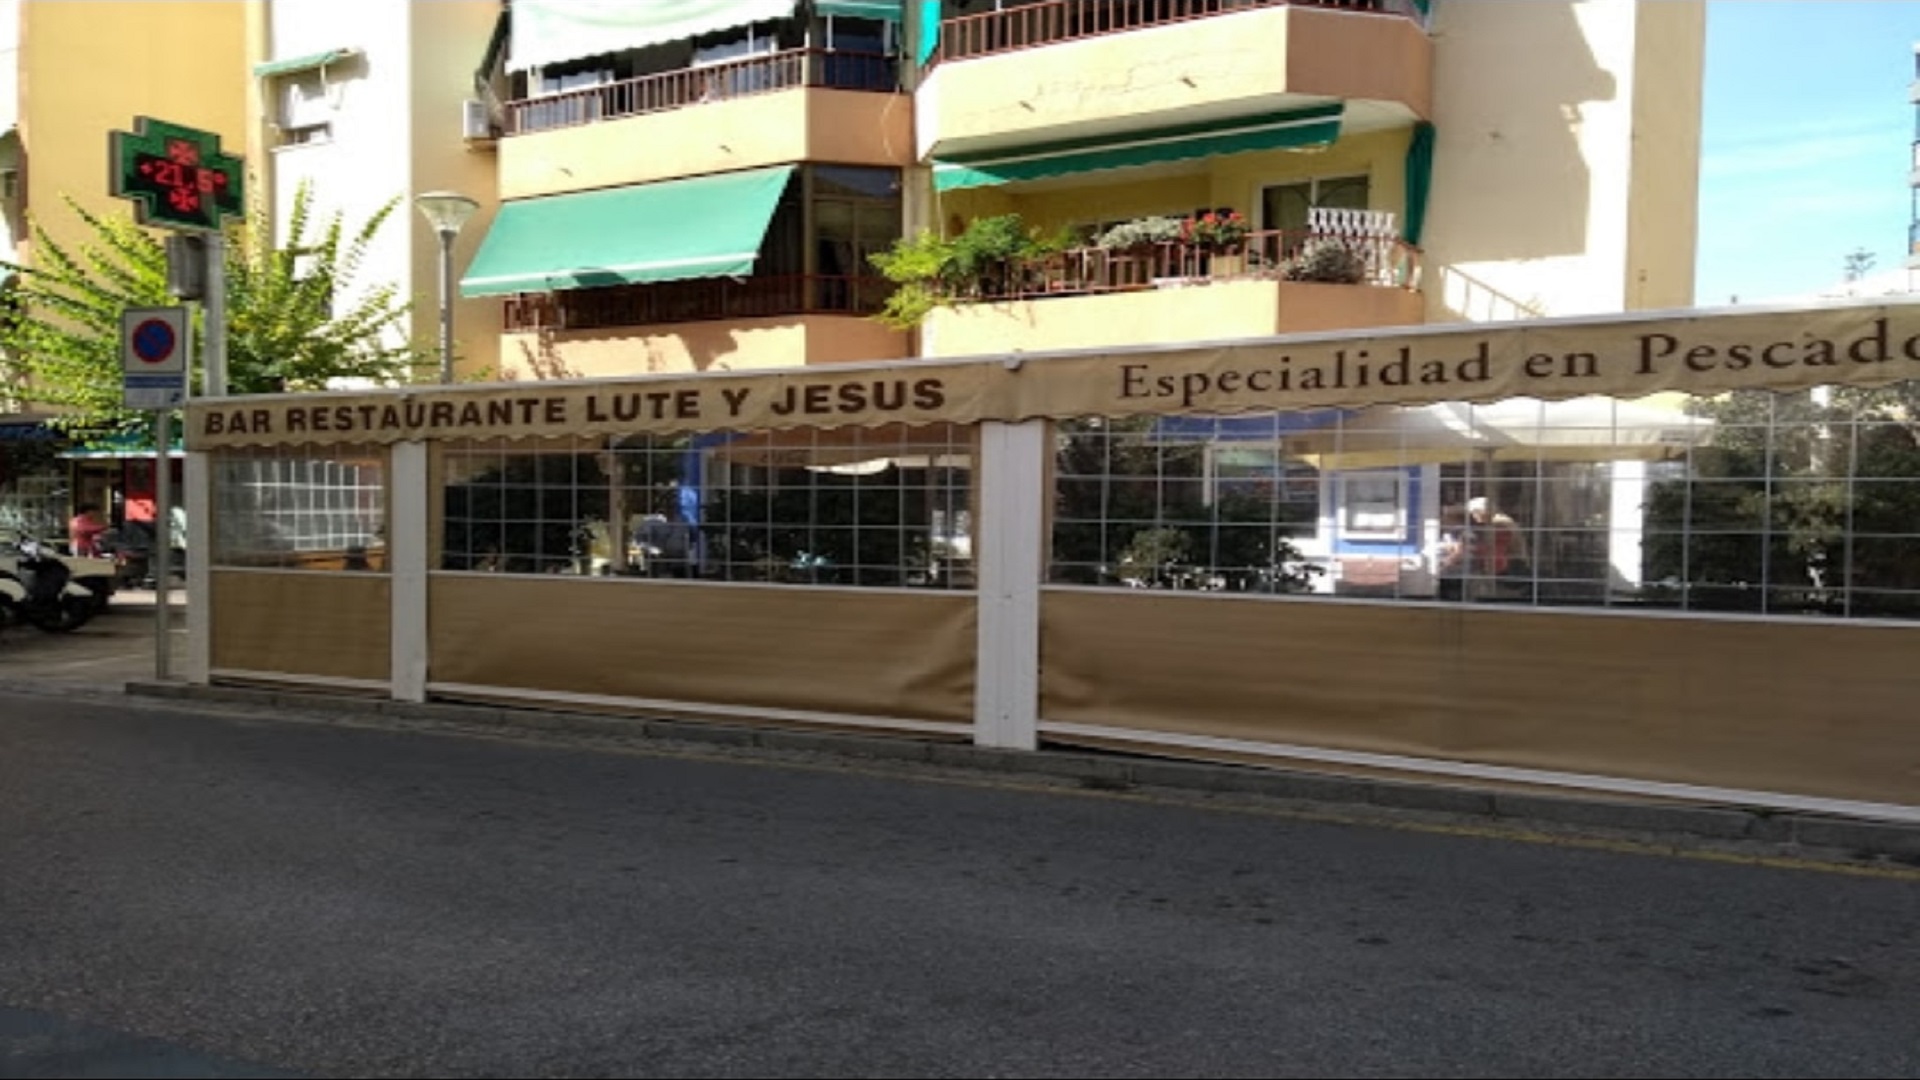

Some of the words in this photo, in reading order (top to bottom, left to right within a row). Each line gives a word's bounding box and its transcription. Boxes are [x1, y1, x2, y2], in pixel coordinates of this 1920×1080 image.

[1117, 342, 1492, 407] Especialidad
[1524, 351, 1600, 378] en
[205, 409, 271, 435] BAR
[286, 397, 566, 432] RESTAURANTE
[586, 390, 699, 422] LUTE
[721, 387, 750, 416] Y
[770, 378, 945, 415] JESUS
